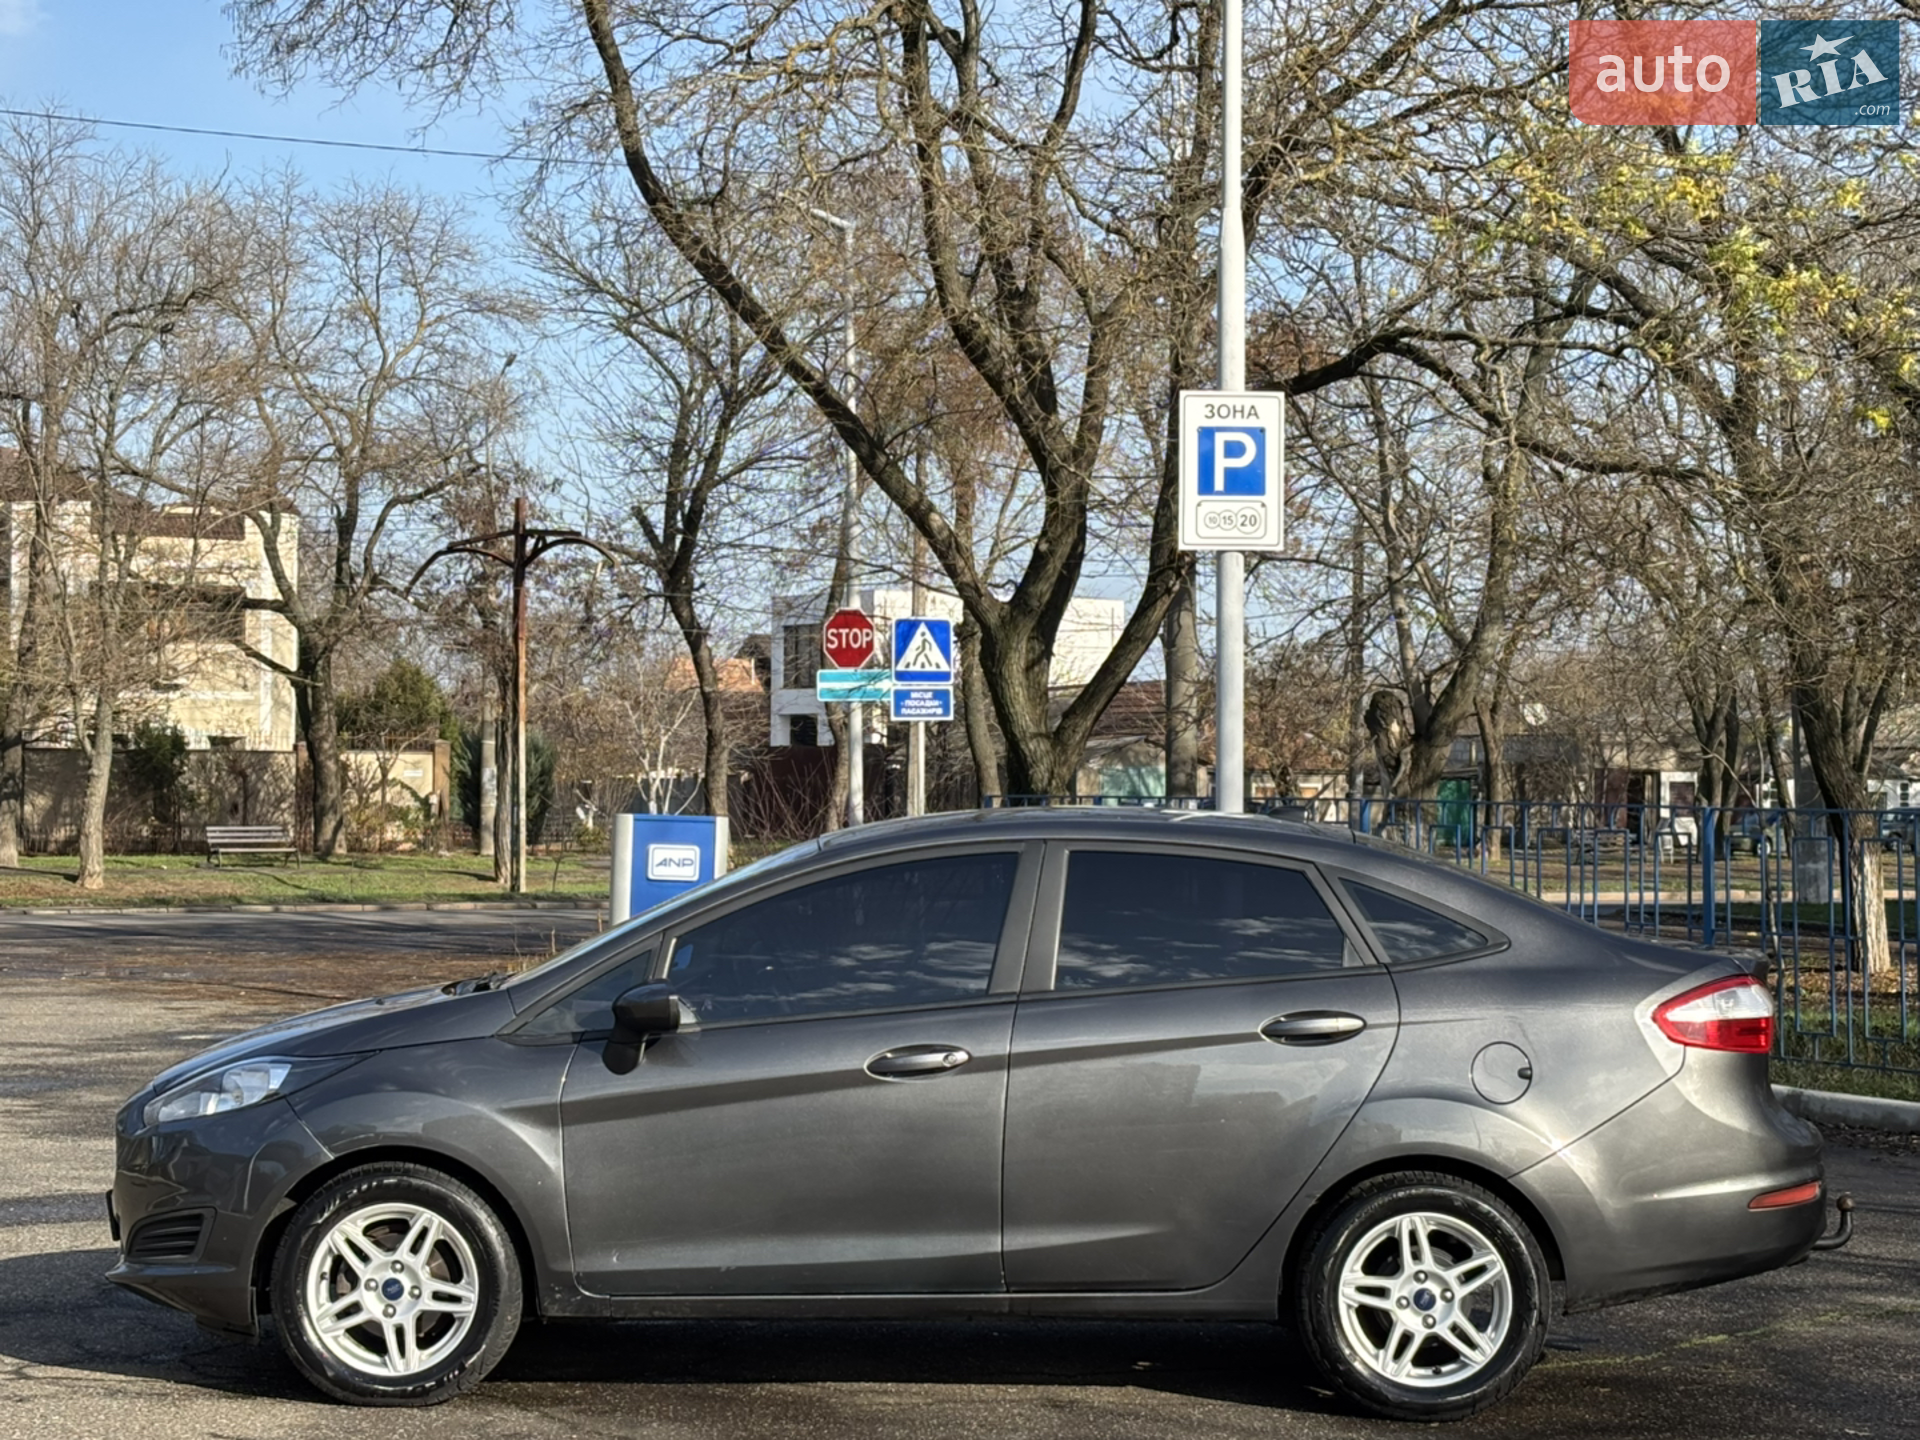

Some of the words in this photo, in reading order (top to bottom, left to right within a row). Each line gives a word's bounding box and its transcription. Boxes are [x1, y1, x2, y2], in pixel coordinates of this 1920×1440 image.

[1204, 403, 1260, 420] ЗОНА
[1214, 431, 1257, 492] P
[1208, 515, 1218, 525] 10
[1221, 516, 1234, 525] 15
[1239, 514, 1258, 527] 20
[827, 628, 873, 649] STOP
[655, 857, 695, 868] ANP
